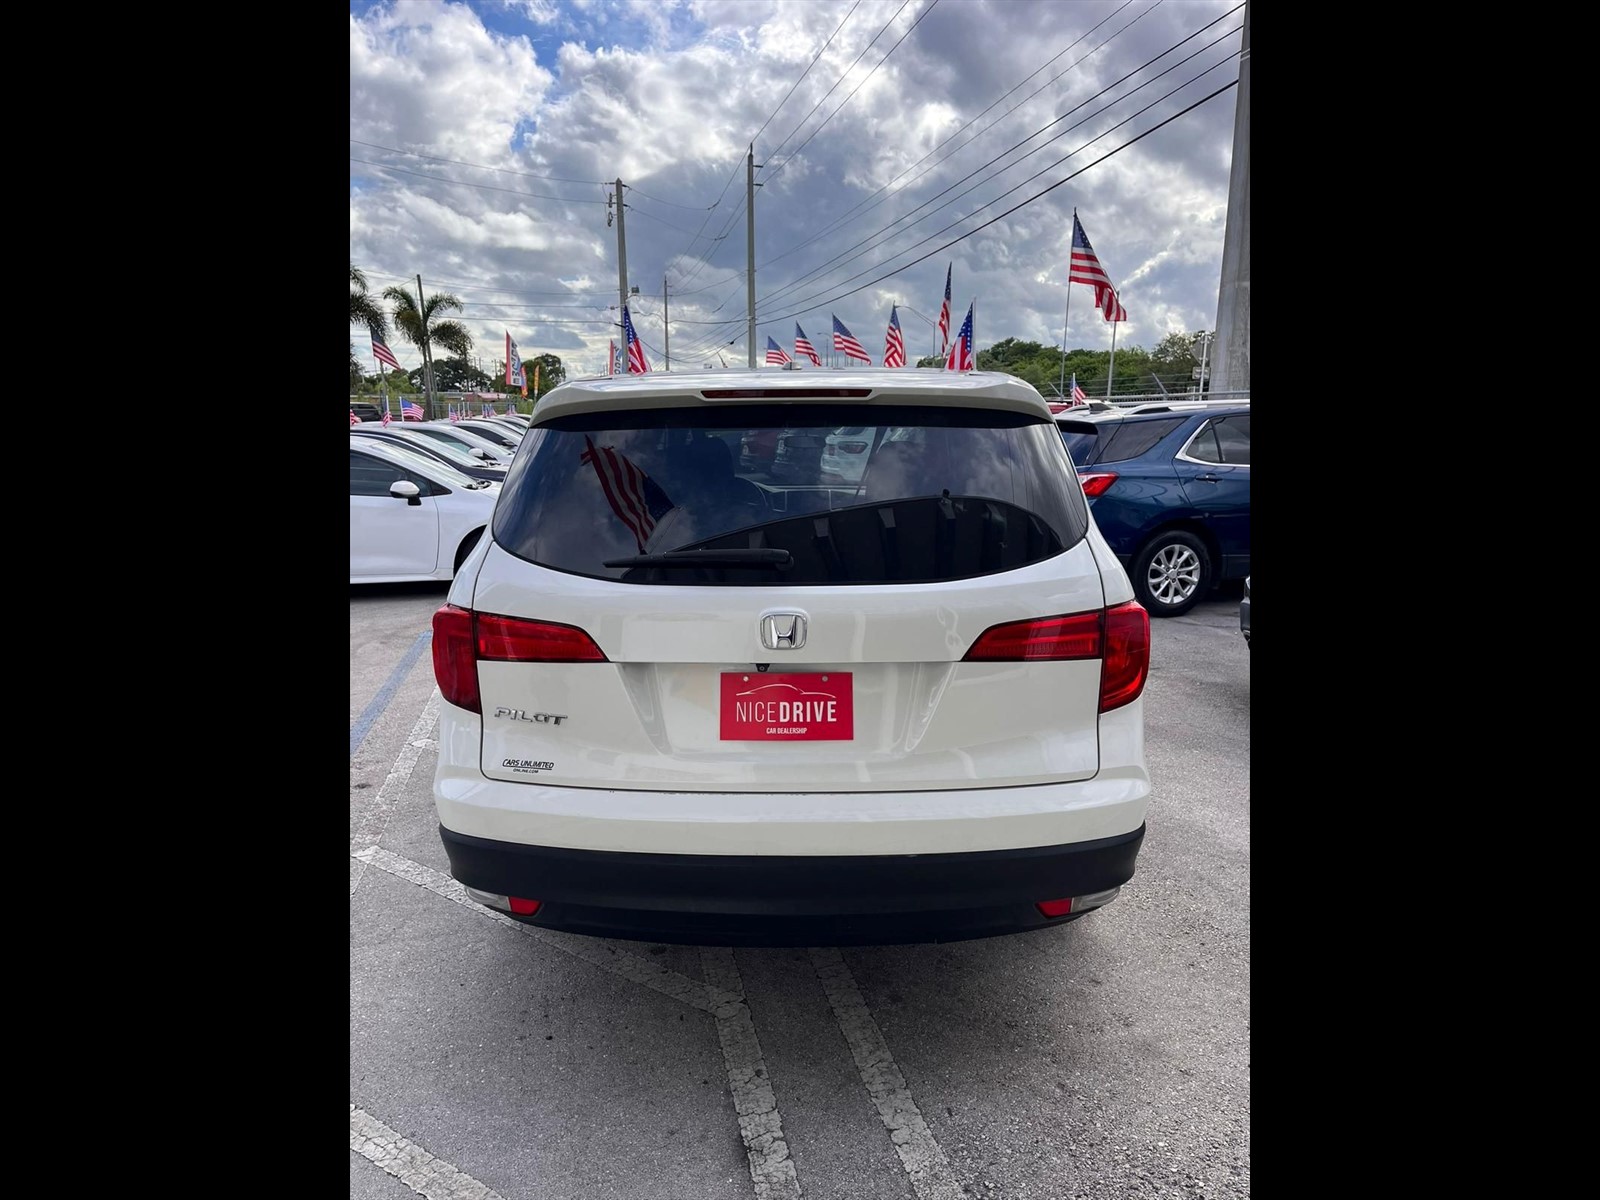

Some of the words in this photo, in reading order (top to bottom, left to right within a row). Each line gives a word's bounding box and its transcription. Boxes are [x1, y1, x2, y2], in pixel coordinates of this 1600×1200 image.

[494, 706, 569, 726] PILOT
[777, 727, 808, 735] DEALERSHIP
[502, 758, 520, 767] CARS
[520, 759, 555, 769] UNLIMITED
